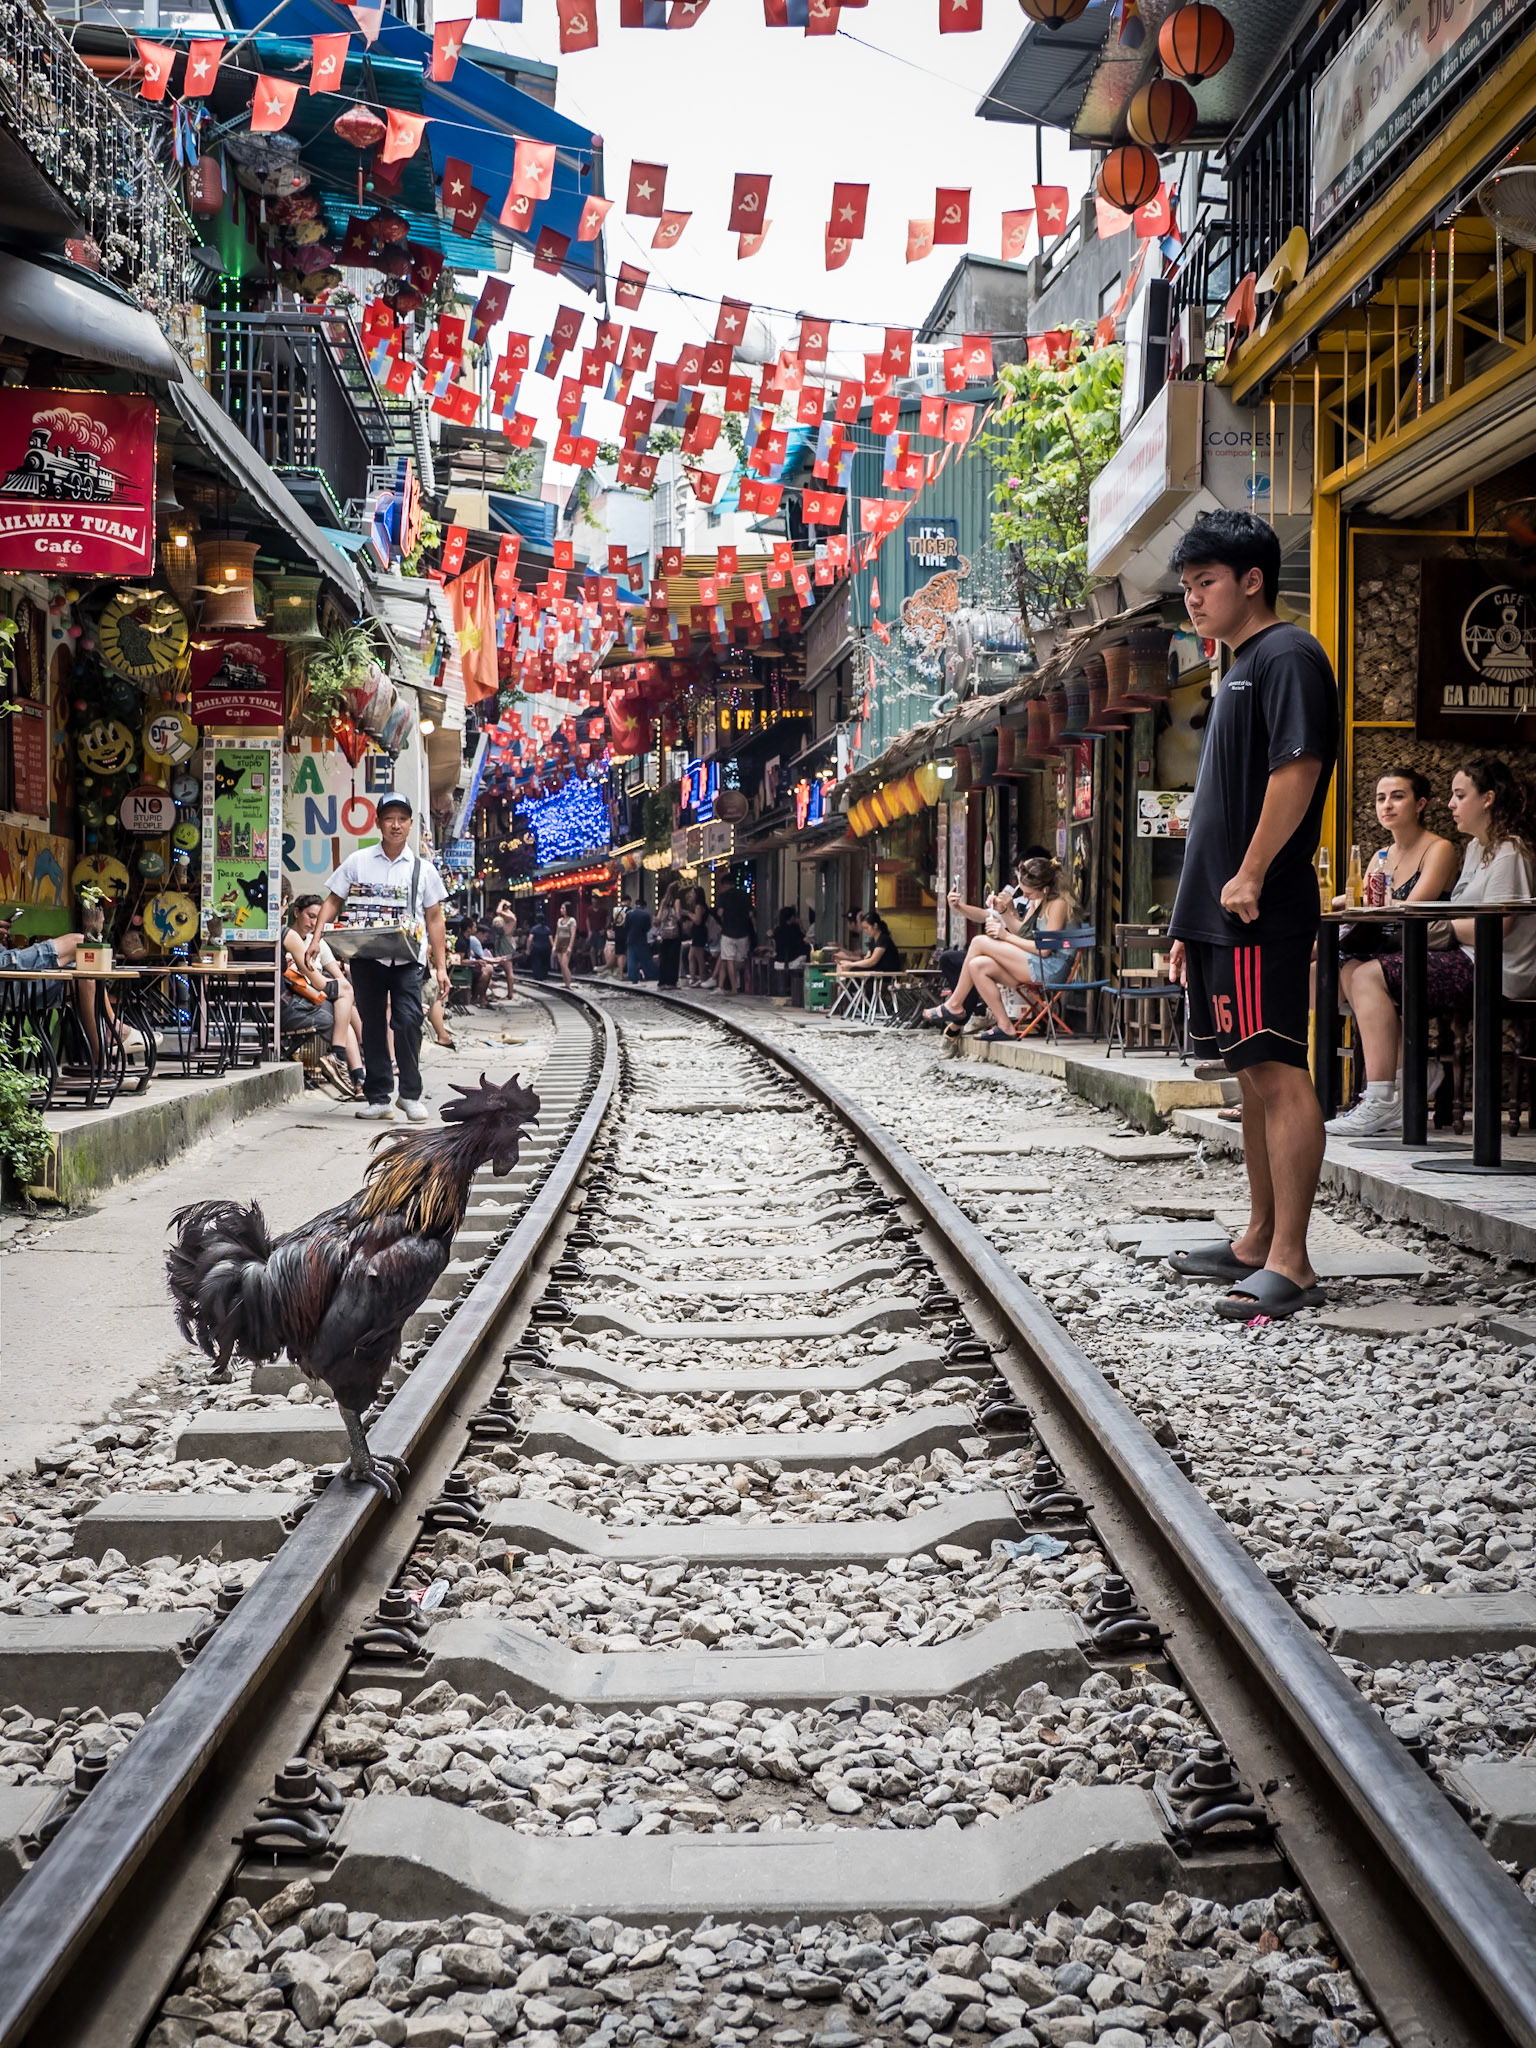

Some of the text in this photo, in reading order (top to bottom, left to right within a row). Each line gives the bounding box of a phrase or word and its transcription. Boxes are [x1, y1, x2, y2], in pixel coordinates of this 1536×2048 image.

[1481, 18, 1491, 41] Tp
[1204, 431, 1285, 447] COREST
[81, 515, 137, 542] TUAN
[920, 526, 945, 539] IT'S
[34, 537, 83, 554] Café
[907, 536, 957, 556] TIGER
[917, 554, 948, 567] TIME
[196, 695, 278, 709] RAILWAY TUAN
[1443, 684, 1465, 706] GA
[1468, 682, 1510, 707] ĐÔNG
[133, 797, 163, 814] NO
[304, 795, 377, 836] NO
[1211, 994, 1233, 1033] 16
